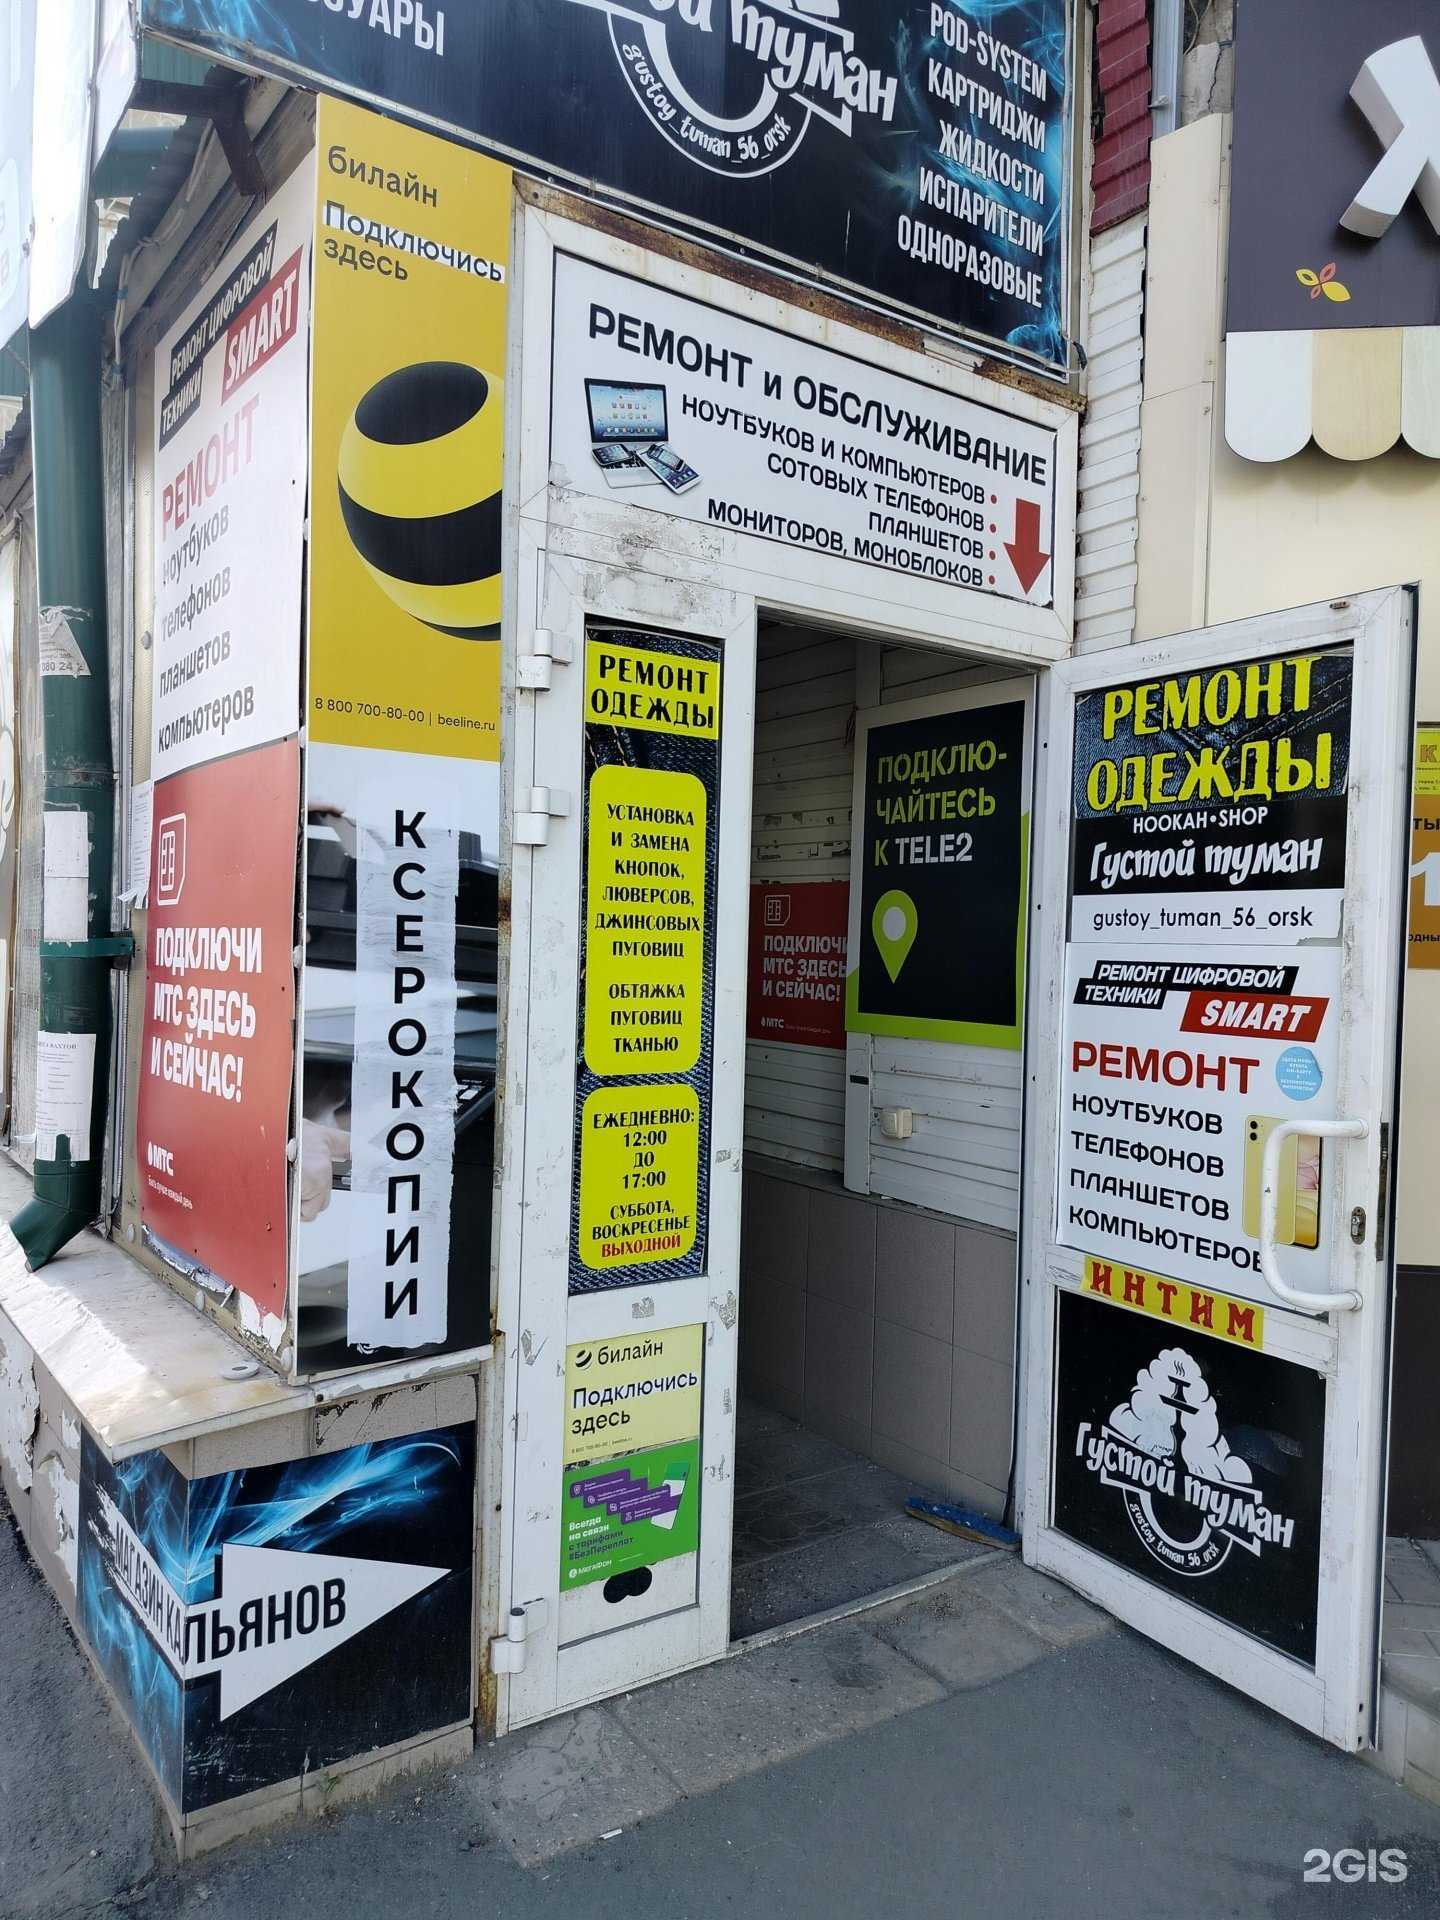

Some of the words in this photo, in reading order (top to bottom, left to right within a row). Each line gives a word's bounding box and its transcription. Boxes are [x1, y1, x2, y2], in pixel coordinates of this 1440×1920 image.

[930, 2, 1047, 101] POD-SYSTEM
[928, 58, 1046, 153] КАРТРИДЖИ
[328, 145, 438, 207] билайн
[938, 120, 1045, 205] ЖИДКОСТИ
[919, 166, 1044, 256] ИСПАРИТЕЛИ
[324, 239, 408, 281] здесь
[325, 199, 503, 284] Подключись
[897, 214, 1043, 309] ОДНОРАЗОВЫЕ
[171, 322, 209, 386] РЕМОНТ
[209, 231, 274, 341] ЦИФРОВОЙ
[225, 268, 297, 391] SMART
[161, 367, 203, 436] ТЕХНИКИ
[589, 303, 752, 388] РЕМОНТ
[763, 370, 782, 400] и
[793, 375, 1047, 487] ОБСЛУЖИВАНИЕ
[162, 393, 259, 542] РЕМОНТ
[682, 393, 814, 452] НОУТБУКОВ
[822, 437, 835, 459] И
[841, 443, 986, 504] КОМПЬЮТЕРОВ
[767, 453, 867, 499] СОТОВЫХ
[874, 483, 984, 533] ТЕЛЕФОНОВ
[707, 498, 849, 558] МОНИТОРОВ,
[854, 537, 983, 587] МОНОБЛОКОВ
[869, 512, 984, 559] ПЛАНШЕТОВ
[162, 566, 231, 642] телефонов
[159, 630, 231, 698] планшетов
[599, 654, 709, 694] РЕМОНТ
[315, 698, 323, 709] 8
[327, 699, 352, 713] 800
[357, 702, 424, 722] 700-80-00
[438, 713, 495, 731] beeline.ru
[591, 688, 713, 729] ОДЕЖДЫ
[1103, 655, 1321, 740] РЕМОНТ
[158, 686, 254, 753] компьютеров
[877, 739, 1007, 784] ПОДКЛЮ-
[1087, 732, 1332, 813] ОДЕЖДЫ
[607, 803, 694, 826] УСТАНОВКА
[876, 787, 996, 825] ЧАЙТЕСЬ
[611, 831, 622, 847] И
[630, 832, 690, 852] ЗАМЕНА
[874, 839, 888, 867] К
[894, 832, 973, 865] TELE2
[615, 859, 685, 880] КНОПОК,
[1090, 839, 1195, 889] Густой
[1204, 837, 1324, 886] туман
[602, 886, 695, 906] ЛЮВЕРСОВ,
[595, 912, 700, 931] ДЖИНСОВЫХ
[1093, 906, 1313, 931] gustoy_tuman_56_orsk
[154, 927, 262, 976] ПОДКЛЮЧИ
[612, 940, 684, 958] ПУГОВИЦ
[763, 957, 794, 975] МТС
[608, 983, 685, 999] ОБТЯЖКА
[762, 980, 772, 996] И
[776, 978, 840, 1002] СЕЙЧАС!
[1085, 985, 1162, 1006] ТЕХНИКИ
[1097, 964, 1171, 984] РЕМОНТ
[1172, 965, 1285, 989] ЦИФРОВОЙ
[153, 982, 182, 1026] МТС
[186, 987, 256, 1041] ЗДЕСЬ
[610, 1010, 683, 1026] ПУГОВИЦ
[1200, 999, 1312, 1033] SMART
[384, 809, 427, 1319] КСЕРОКОПИИ
[613, 1036, 679, 1053] ТКАНЬЮ
[150, 1036, 160, 1076] И
[163, 1032, 243, 1103] СЕЙЧАС!
[1072, 1041, 1260, 1094] РЕМОНТ
[593, 1108, 695, 1129] ЕЖЕДНЕВНО:
[1072, 1093, 1223, 1135] НОУТБУКОВ
[624, 1130, 667, 1147] 12:00
[1071, 1130, 1224, 1177] ТЕЛЕФОНОВ
[153, 1144, 174, 1176] МТС
[622, 1171, 666, 1190] 17:00
[633, 1151, 655, 1169] ДО
[610, 1199, 675, 1221] СУББОТА,
[1071, 1168, 1230, 1221] ПЛАНШЕТОВ
[592, 1215, 690, 1240] ВОСКРЕСЕНЬЕ
[601, 1232, 681, 1258] ВЫХОДНОЙ
[1090, 1260, 1256, 1343] ИНТИМ
[597, 1339, 664, 1365] билайн
[573, 1370, 698, 1410] Подключись
[571, 1409, 631, 1436] здесь
[1075, 1422, 1176, 1497] Густой
[1184, 1475, 1295, 1549] туман
[569, 1516, 602, 1531] Всегда
[114, 1520, 164, 1633] МАГАЗИН
[166, 1577, 346, 1665] КАЛЬЯНОВ
